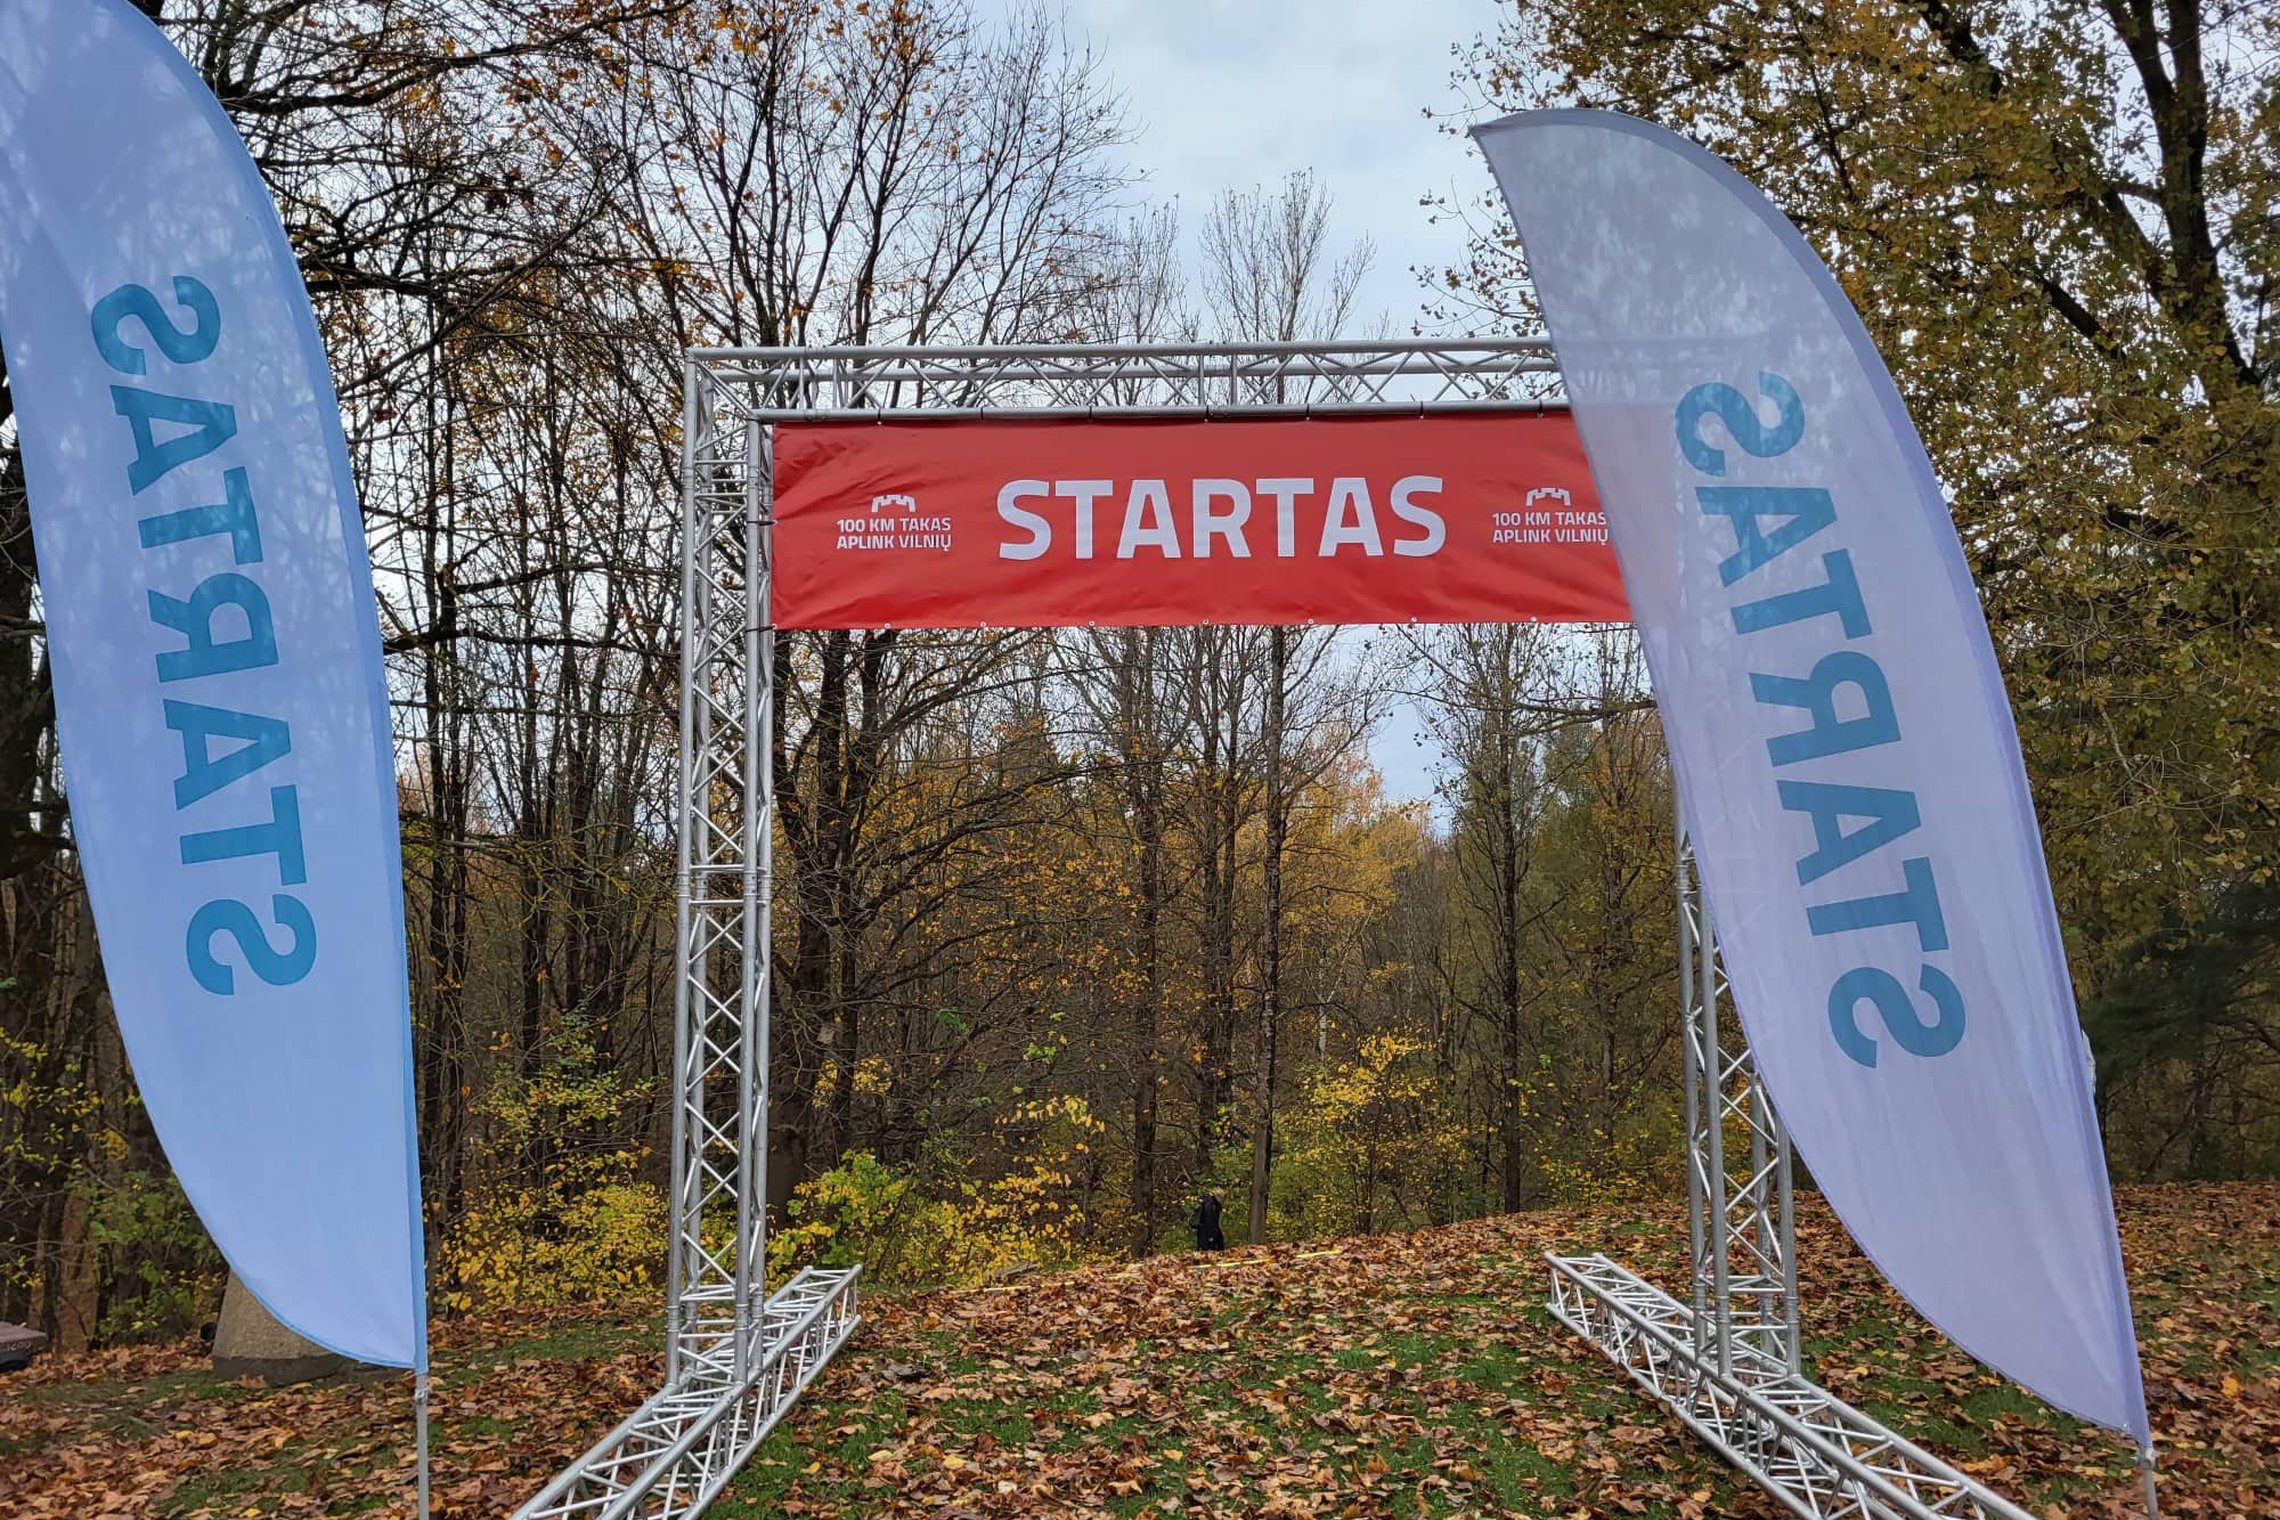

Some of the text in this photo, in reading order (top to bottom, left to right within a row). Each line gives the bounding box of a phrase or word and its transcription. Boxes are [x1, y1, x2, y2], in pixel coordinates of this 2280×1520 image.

[836, 517, 952, 533] 100 KM TAKAS
[996, 475, 1447, 561] STARTAS
[1491, 511, 1608, 527] 100 KM TAKAS
[836, 533, 952, 552] APLINK VILNIŲ
[1492, 528, 1609, 546] APLINK VILNIŲ
